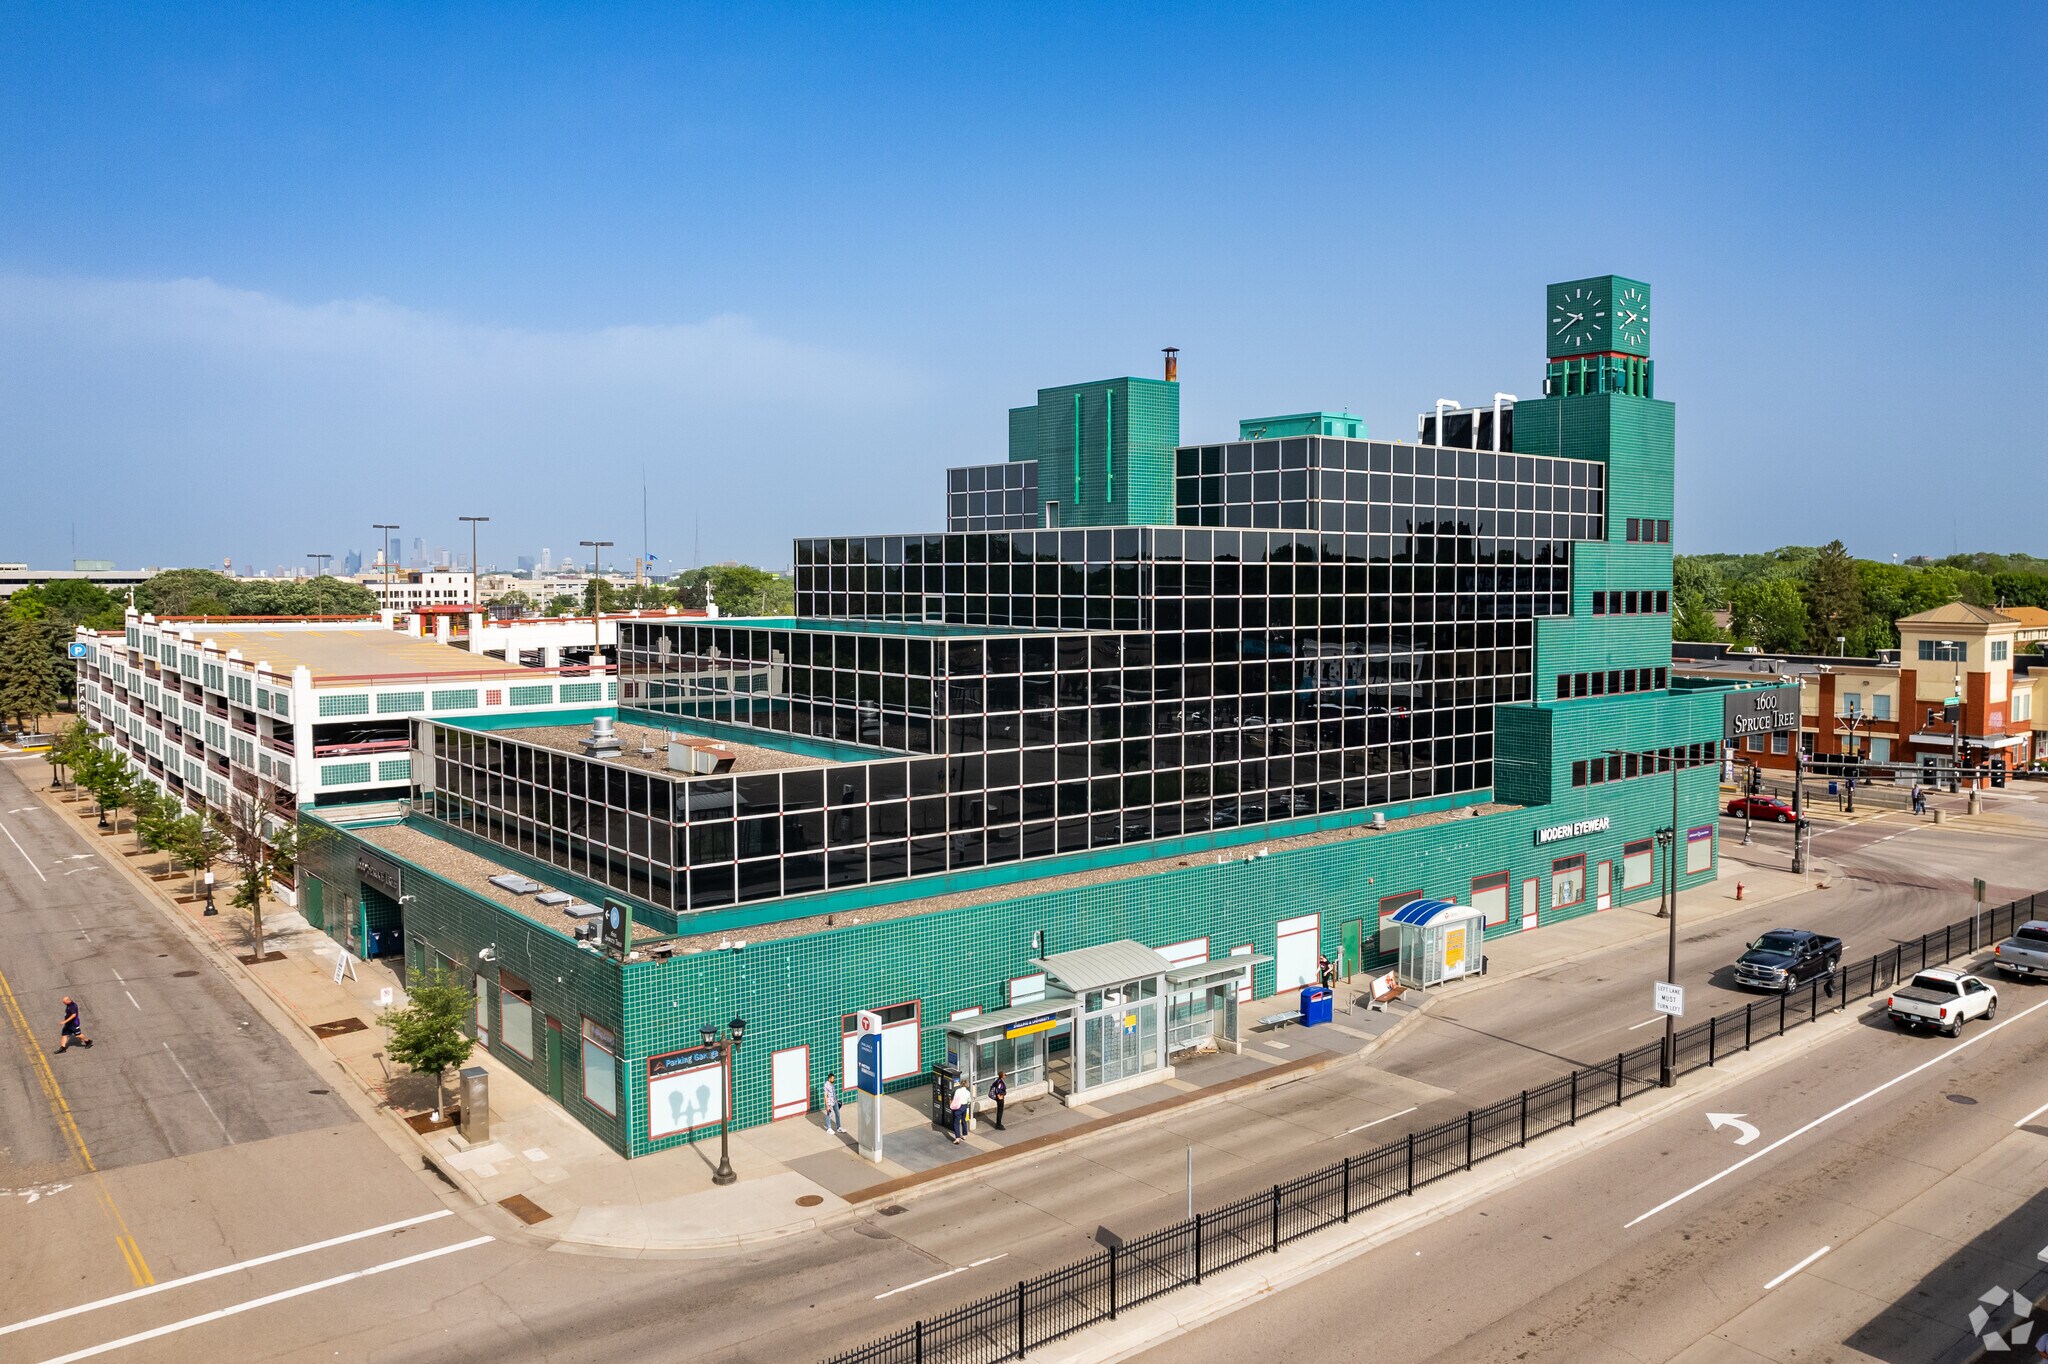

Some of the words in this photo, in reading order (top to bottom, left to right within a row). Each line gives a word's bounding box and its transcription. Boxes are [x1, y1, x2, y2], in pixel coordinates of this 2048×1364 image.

[74, 646, 82, 655] P
[1756, 692, 1777, 710] 1600
[1735, 714, 1770, 733] SPRUCE
[1773, 710, 1795, 728] TREE
[1540, 824, 1573, 842] MODERN
[1574, 817, 1610, 835] EYEWEAR
[1661, 995, 1676, 1003] MUST
[665, 1055, 692, 1067] Parking
[693, 1050, 719, 1061] Garge
